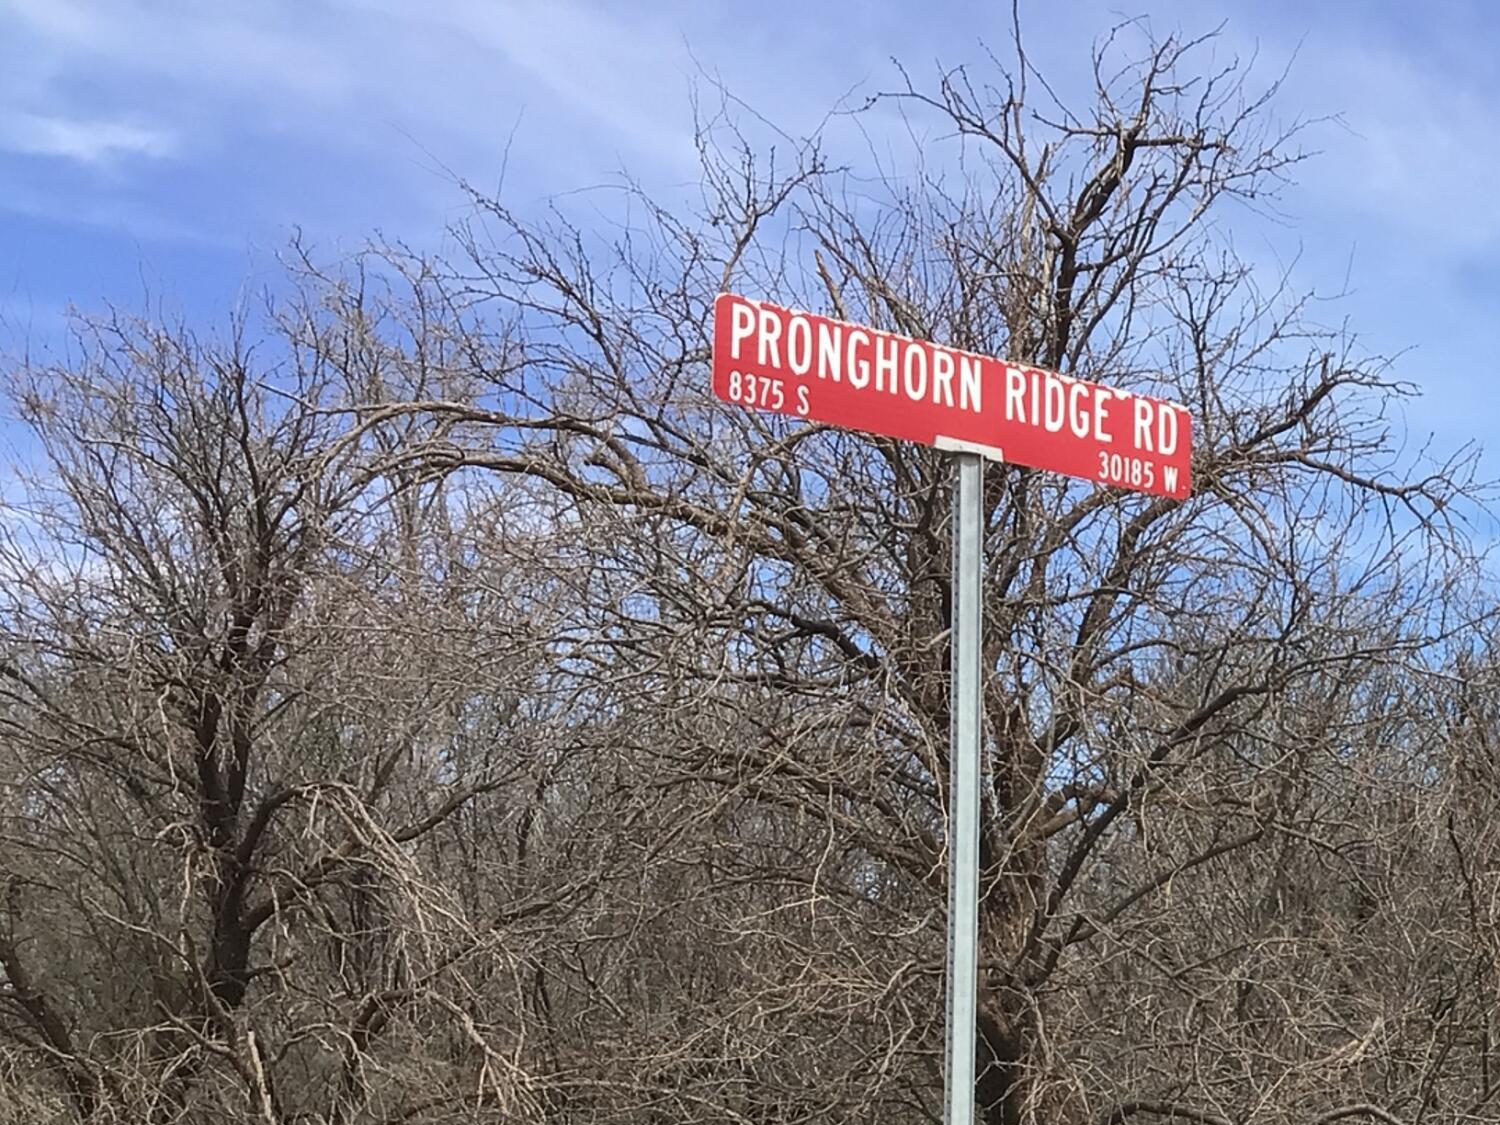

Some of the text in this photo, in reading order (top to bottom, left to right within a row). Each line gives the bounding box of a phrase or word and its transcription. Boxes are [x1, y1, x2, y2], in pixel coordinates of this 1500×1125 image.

[728, 372, 810, 415] 8375 S
[731, 303, 1178, 455] PRONGHORN RIDGE RD
[1098, 451, 1179, 493] 30185 W
